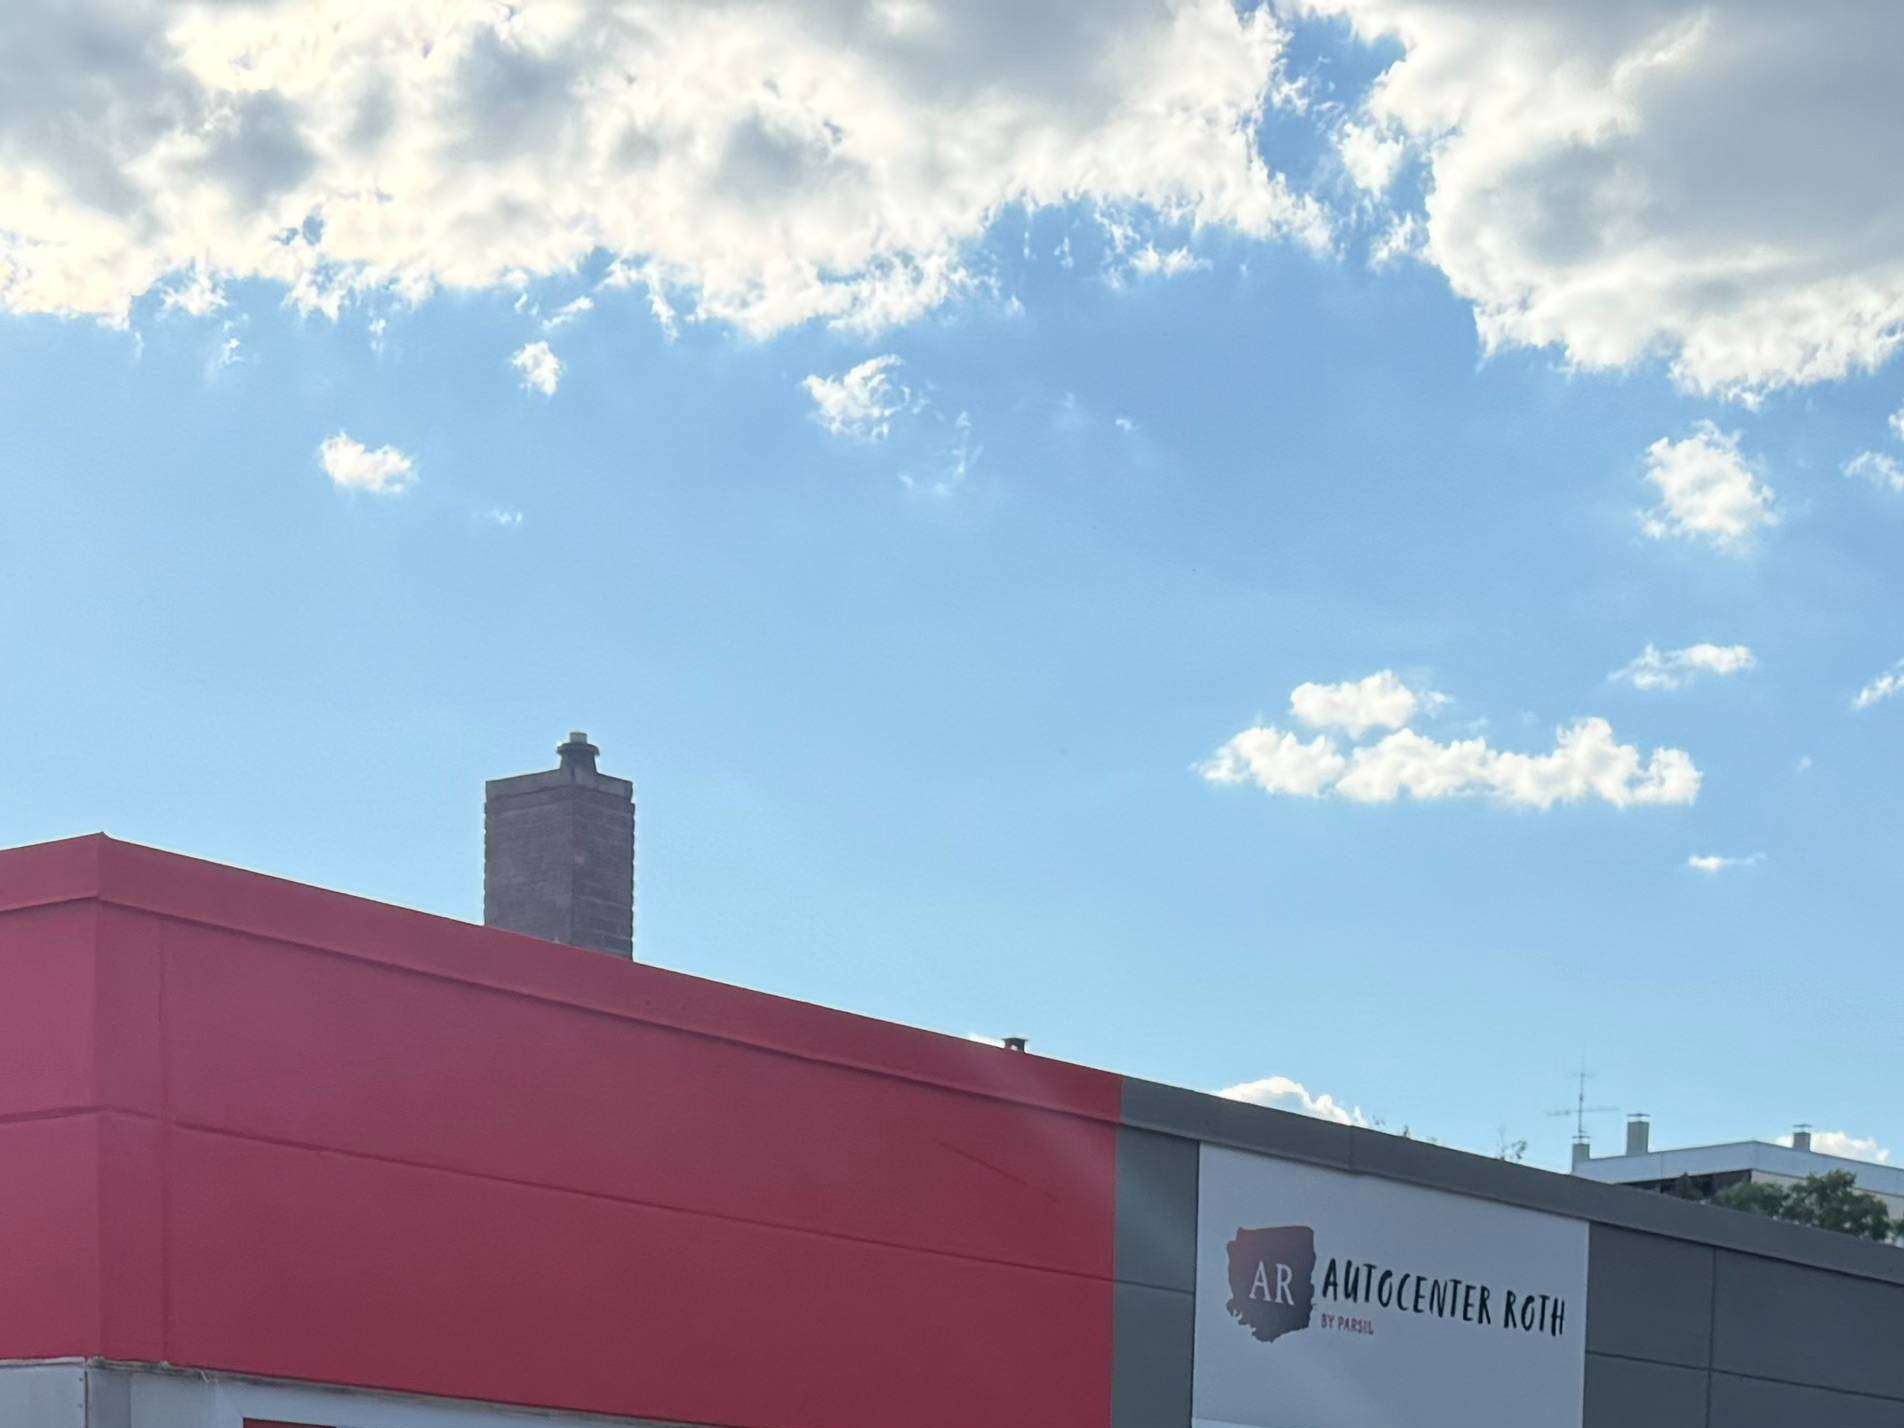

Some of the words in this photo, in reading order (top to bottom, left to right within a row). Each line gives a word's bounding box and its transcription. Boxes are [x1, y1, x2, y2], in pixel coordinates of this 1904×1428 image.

[1248, 1260, 1295, 1306] AR
[1322, 1257, 1492, 1326] AUTOCENTER
[1503, 1289, 1566, 1337] ROTH
[1321, 1313, 1335, 1329] BY
[1337, 1315, 1375, 1336] PARSIL
